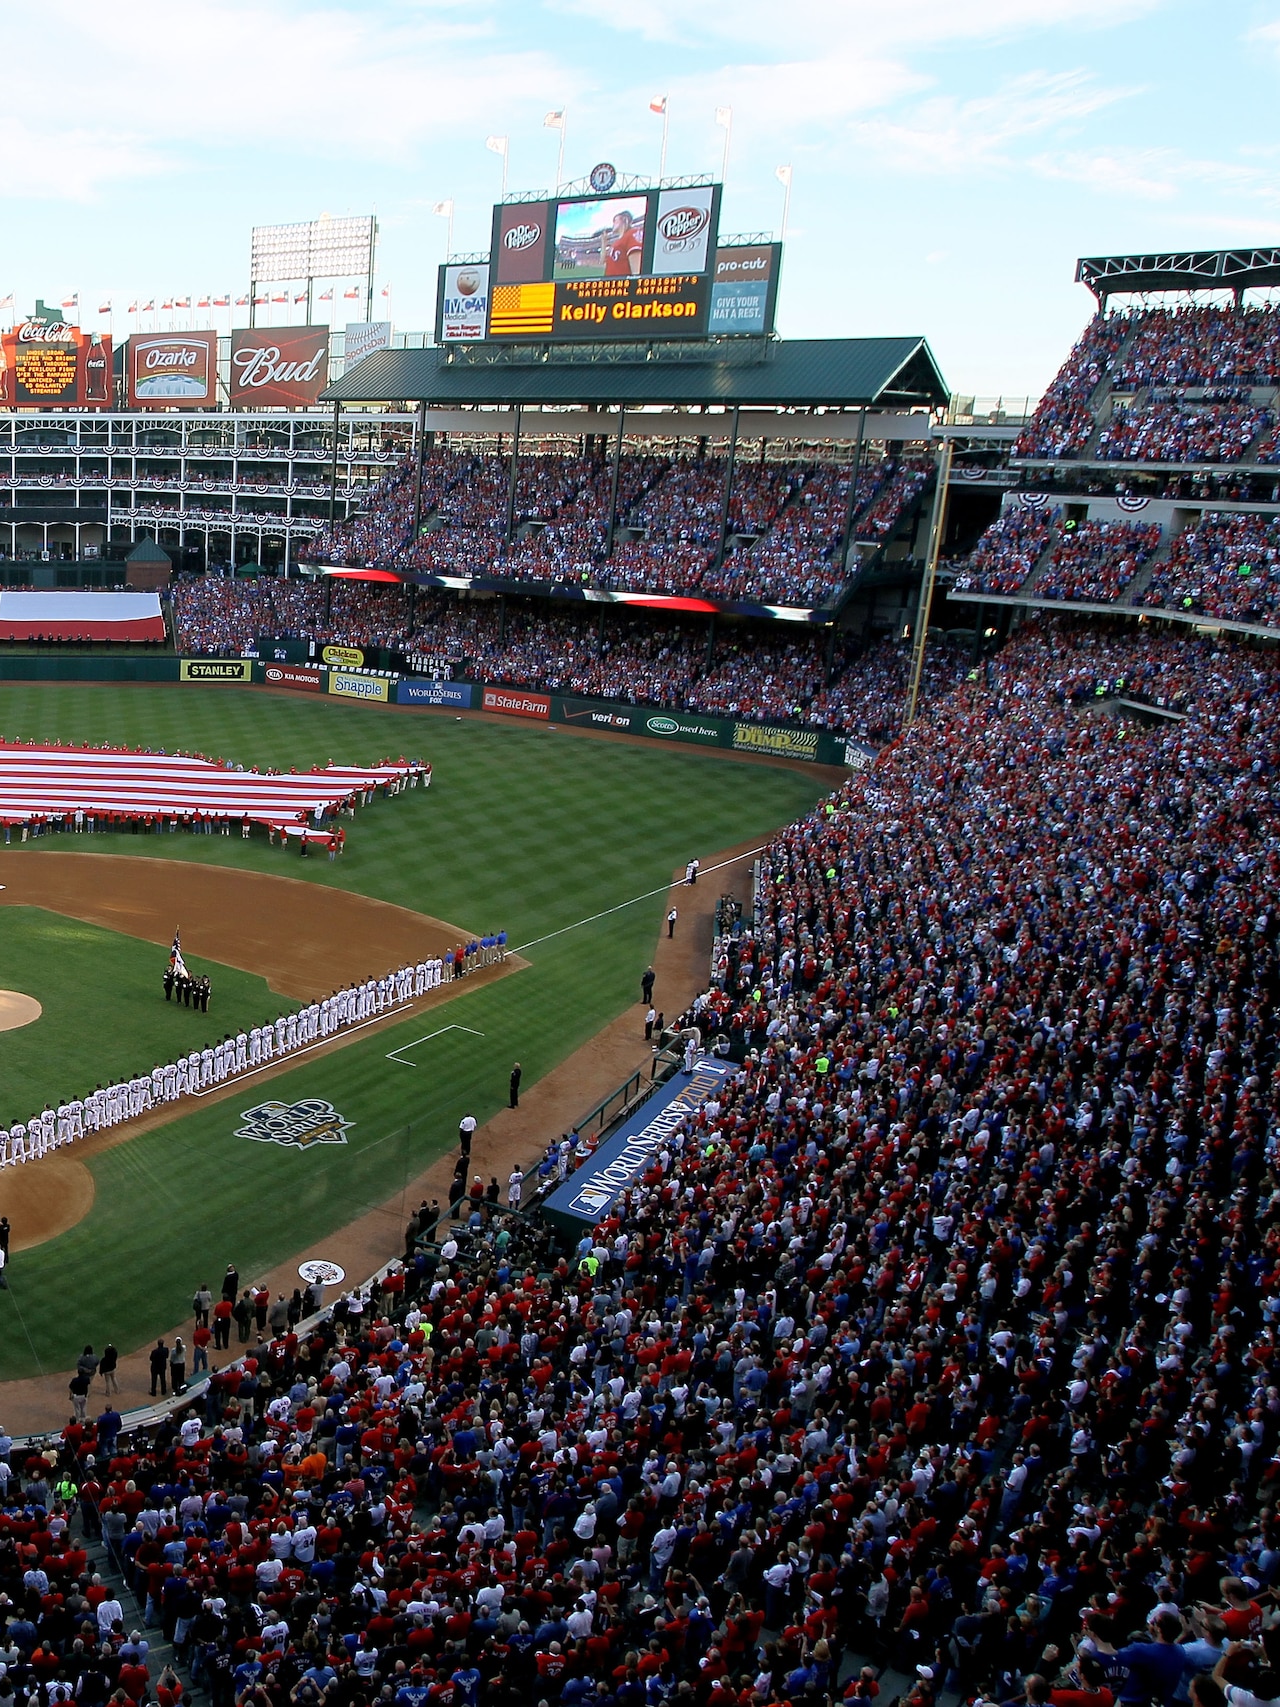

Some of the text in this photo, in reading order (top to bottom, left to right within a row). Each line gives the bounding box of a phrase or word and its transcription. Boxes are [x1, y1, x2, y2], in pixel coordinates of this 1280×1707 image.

[677, 210, 691, 226] Dr
[664, 216, 700, 237] Pepper
[507, 228, 537, 249] Pepper
[566, 280, 630, 290] PERFORMING
[638, 276, 698, 287] TONIGHT'S
[578, 286, 682, 298] NATIONAL ANTHEM:
[717, 296, 759, 307] GIVE YOUR
[561, 300, 697, 323] Kelly Clarkson
[713, 308, 730, 319] HAT
[738, 307, 761, 318] REST.
[31, 317, 47, 325] Enjoy
[346, 336, 386, 361] SportsDay
[145, 348, 197, 369] Ozarka
[233, 346, 326, 387] Bud
[328, 648, 358, 659] Chicken
[406, 656, 445, 667] SHARPER
[192, 666, 240, 675] STANLEY
[295, 675, 319, 684] MOTORS
[335, 676, 382, 697] Snapple
[592, 712, 630, 727] verizon
[651, 720, 675, 730] Scotts
[679, 725, 718, 737] used here.
[676, 1075, 719, 1107] 2010
[239, 1101, 327, 1139] WORLD
[271, 1112, 337, 1143] SERIES
